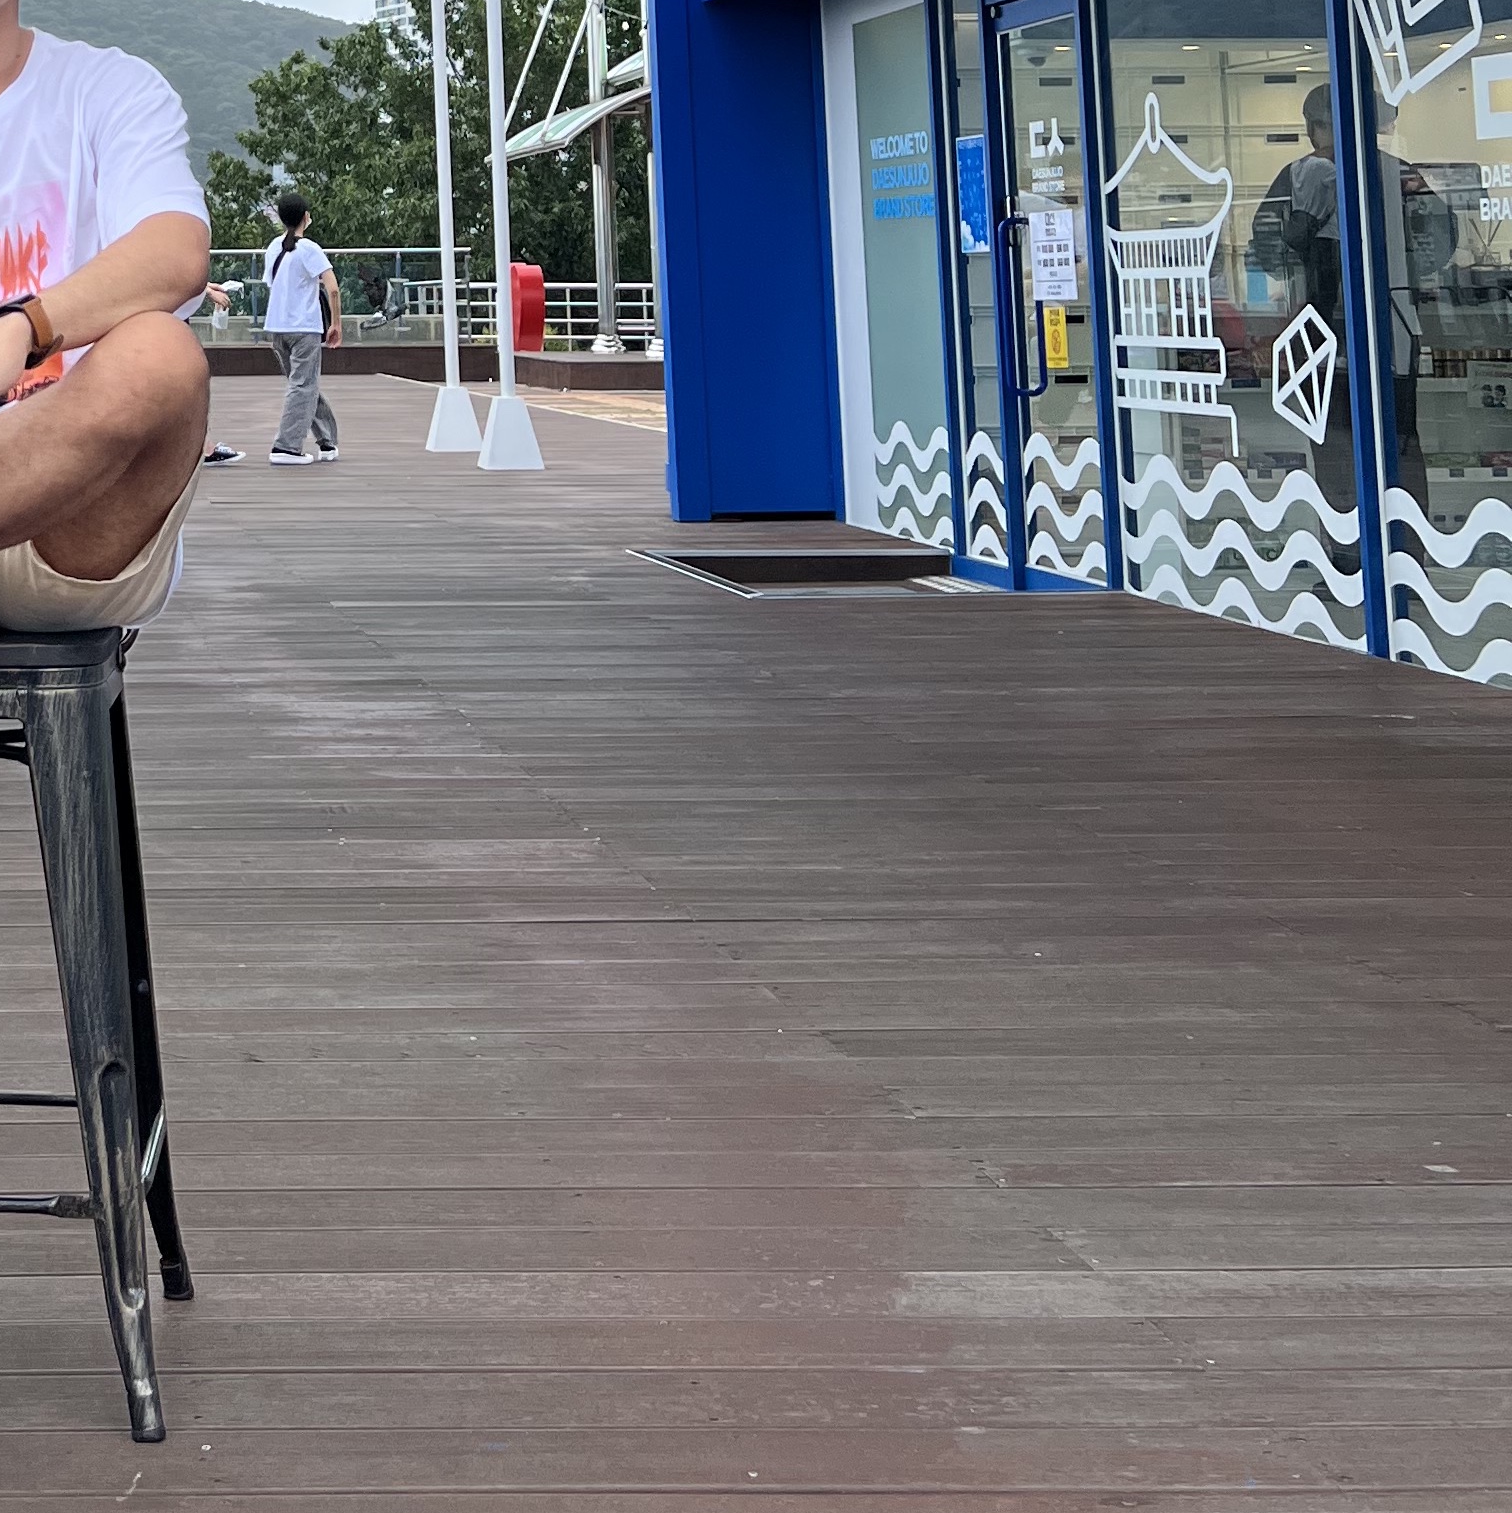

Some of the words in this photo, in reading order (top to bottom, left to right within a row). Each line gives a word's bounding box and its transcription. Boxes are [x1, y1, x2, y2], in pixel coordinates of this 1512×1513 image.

[870, 134, 915, 160] WELCOME
[914, 130, 928, 155] TO
[871, 162, 930, 191] DAESUNJUJO
[873, 196, 904, 221] BRAND
[903, 192, 935, 218] STORE
